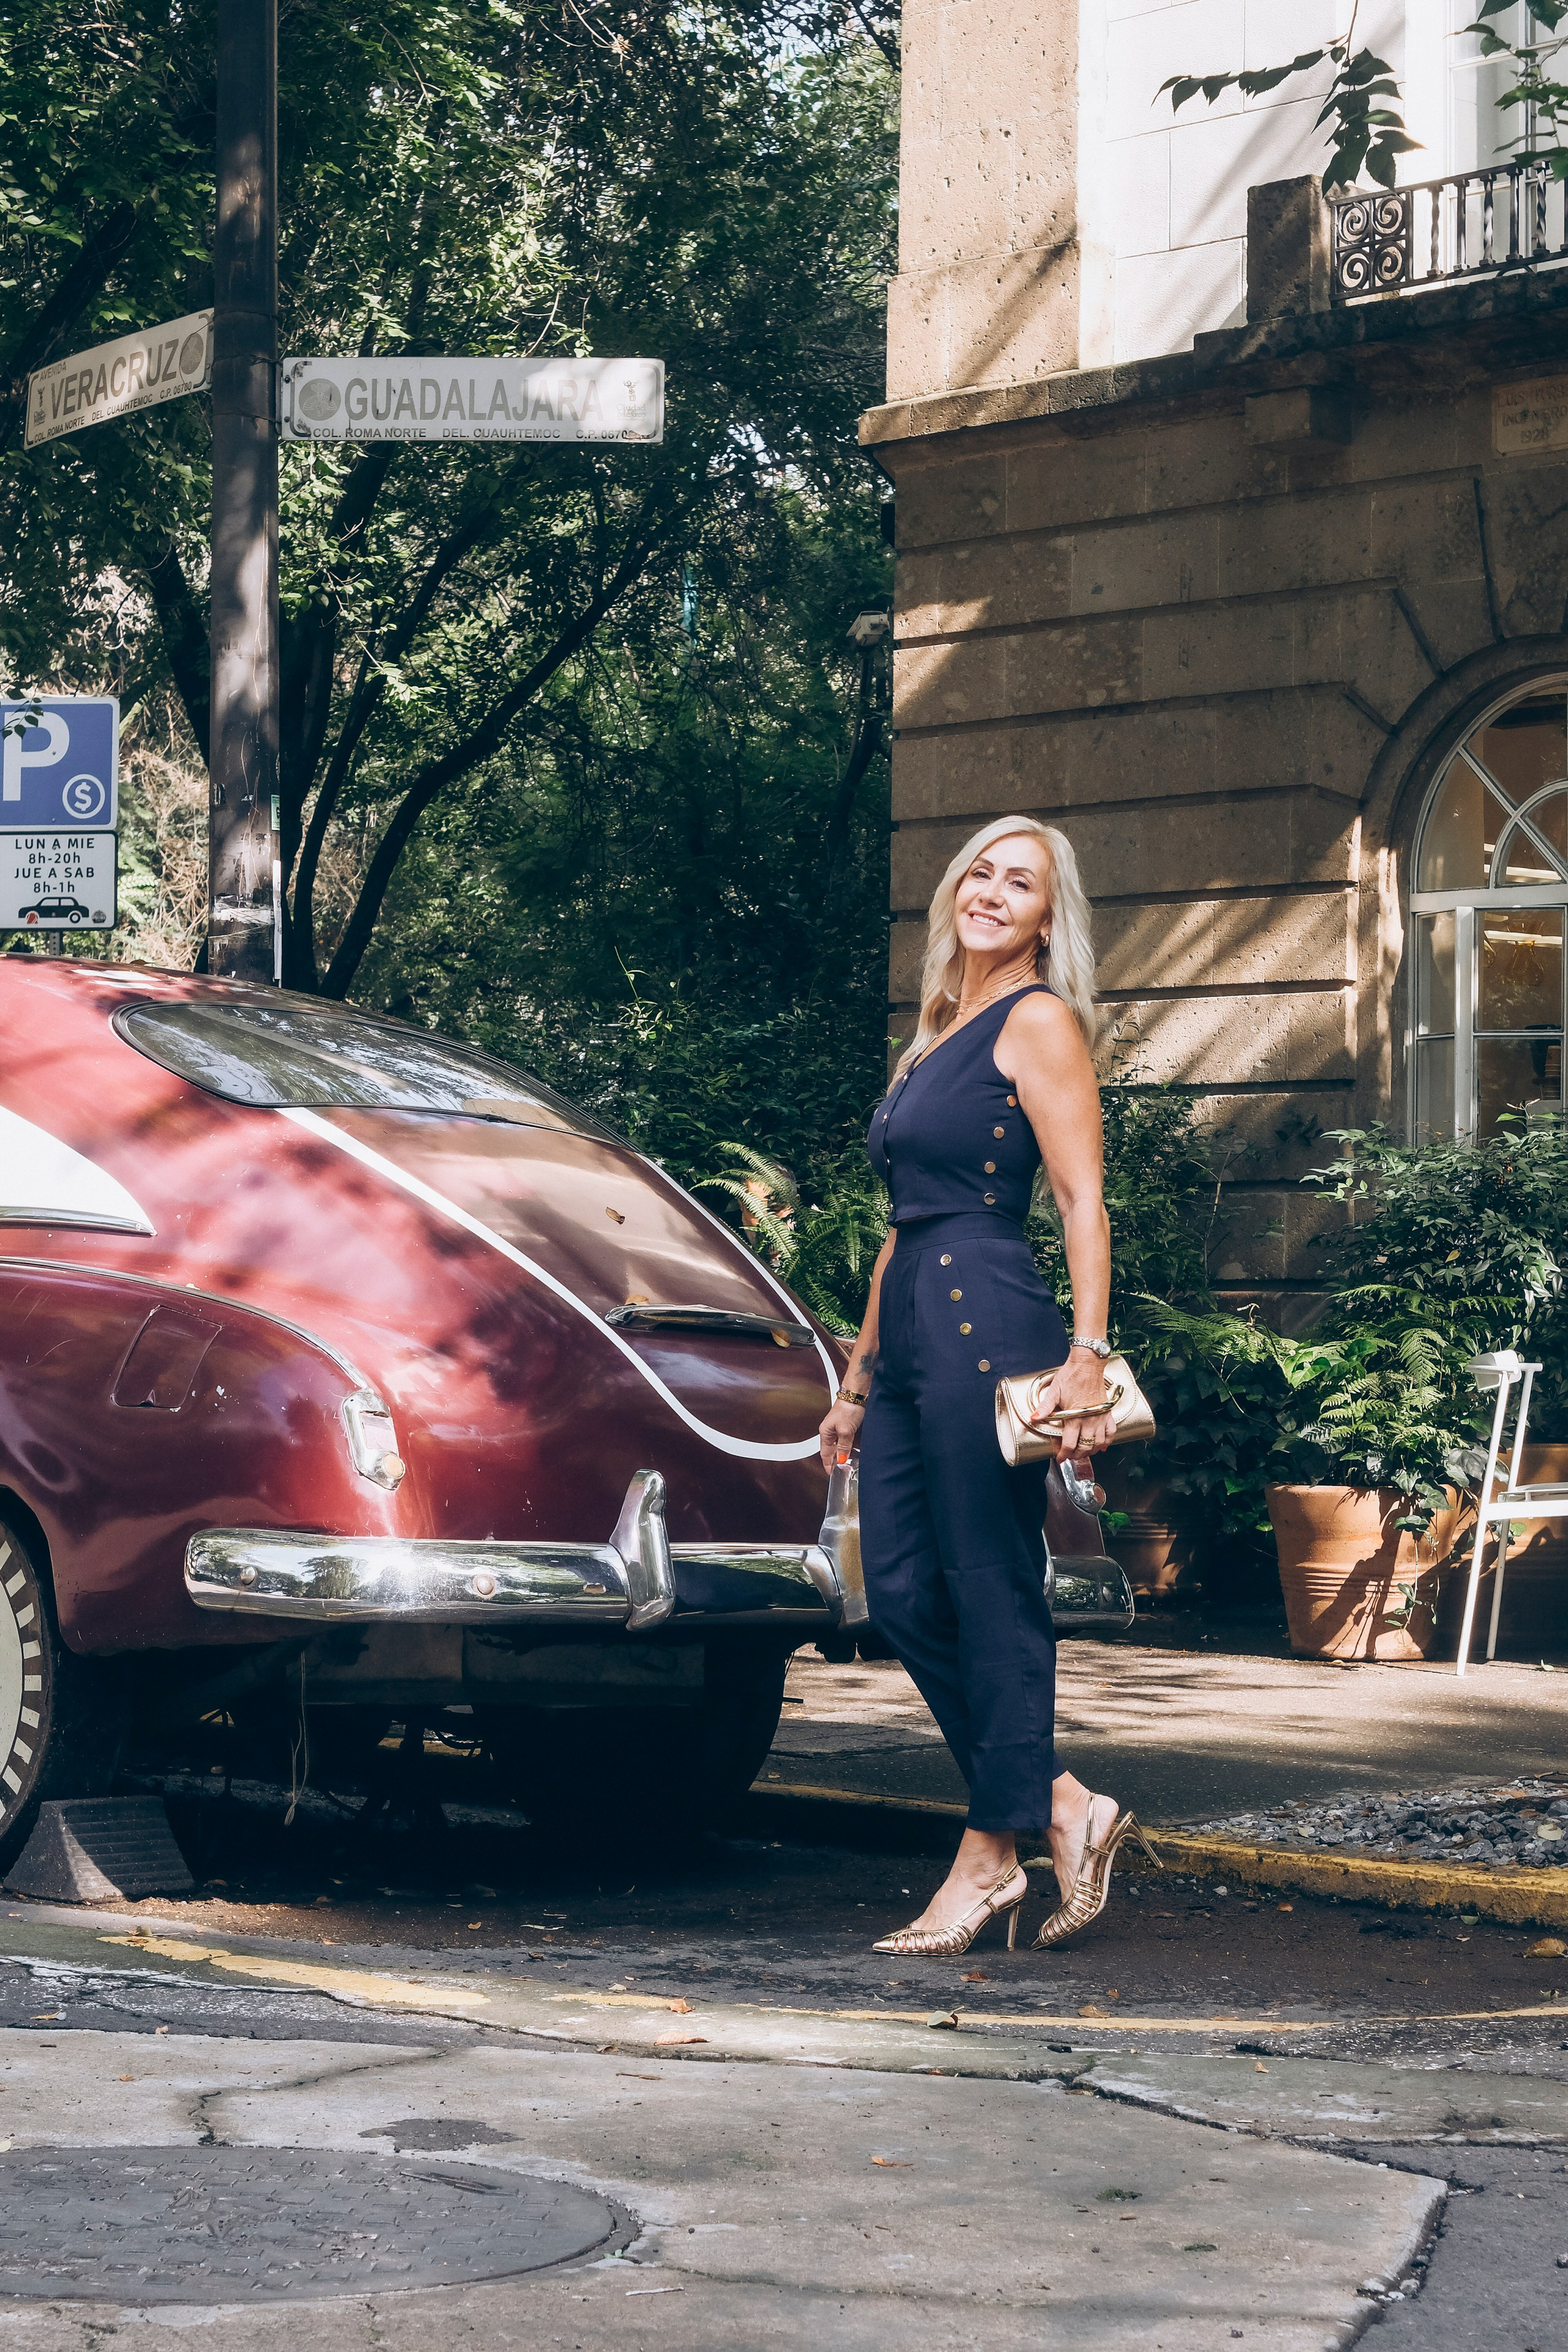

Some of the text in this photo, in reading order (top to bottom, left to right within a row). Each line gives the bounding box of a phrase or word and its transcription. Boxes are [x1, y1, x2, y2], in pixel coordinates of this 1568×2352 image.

[40, 361, 67, 382] AVENIDA
[51, 339, 179, 420] VERACRUZ
[345, 378, 603, 421] GUADALAJARA
[47, 424, 64, 437] ROMA
[64, 416, 85, 431] NORTE
[107, 394, 153, 415] CUAUHTEMOC
[313, 428, 341, 438] COL.
[345, 428, 382, 438] ROMA
[385, 428, 426, 438] NORTE
[442, 428, 470, 438] DEL.
[473, 428, 560, 439] CUAUHTEMOC
[576, 429, 597, 439] C.P.
[2, 711, 70, 801] P
[15, 838, 94, 850] LUN A MIE
[29, 852, 80, 864] 8h-20h
[14, 867, 94, 878] JUE A SAB
[34, 881, 75, 893] 8h-1h
